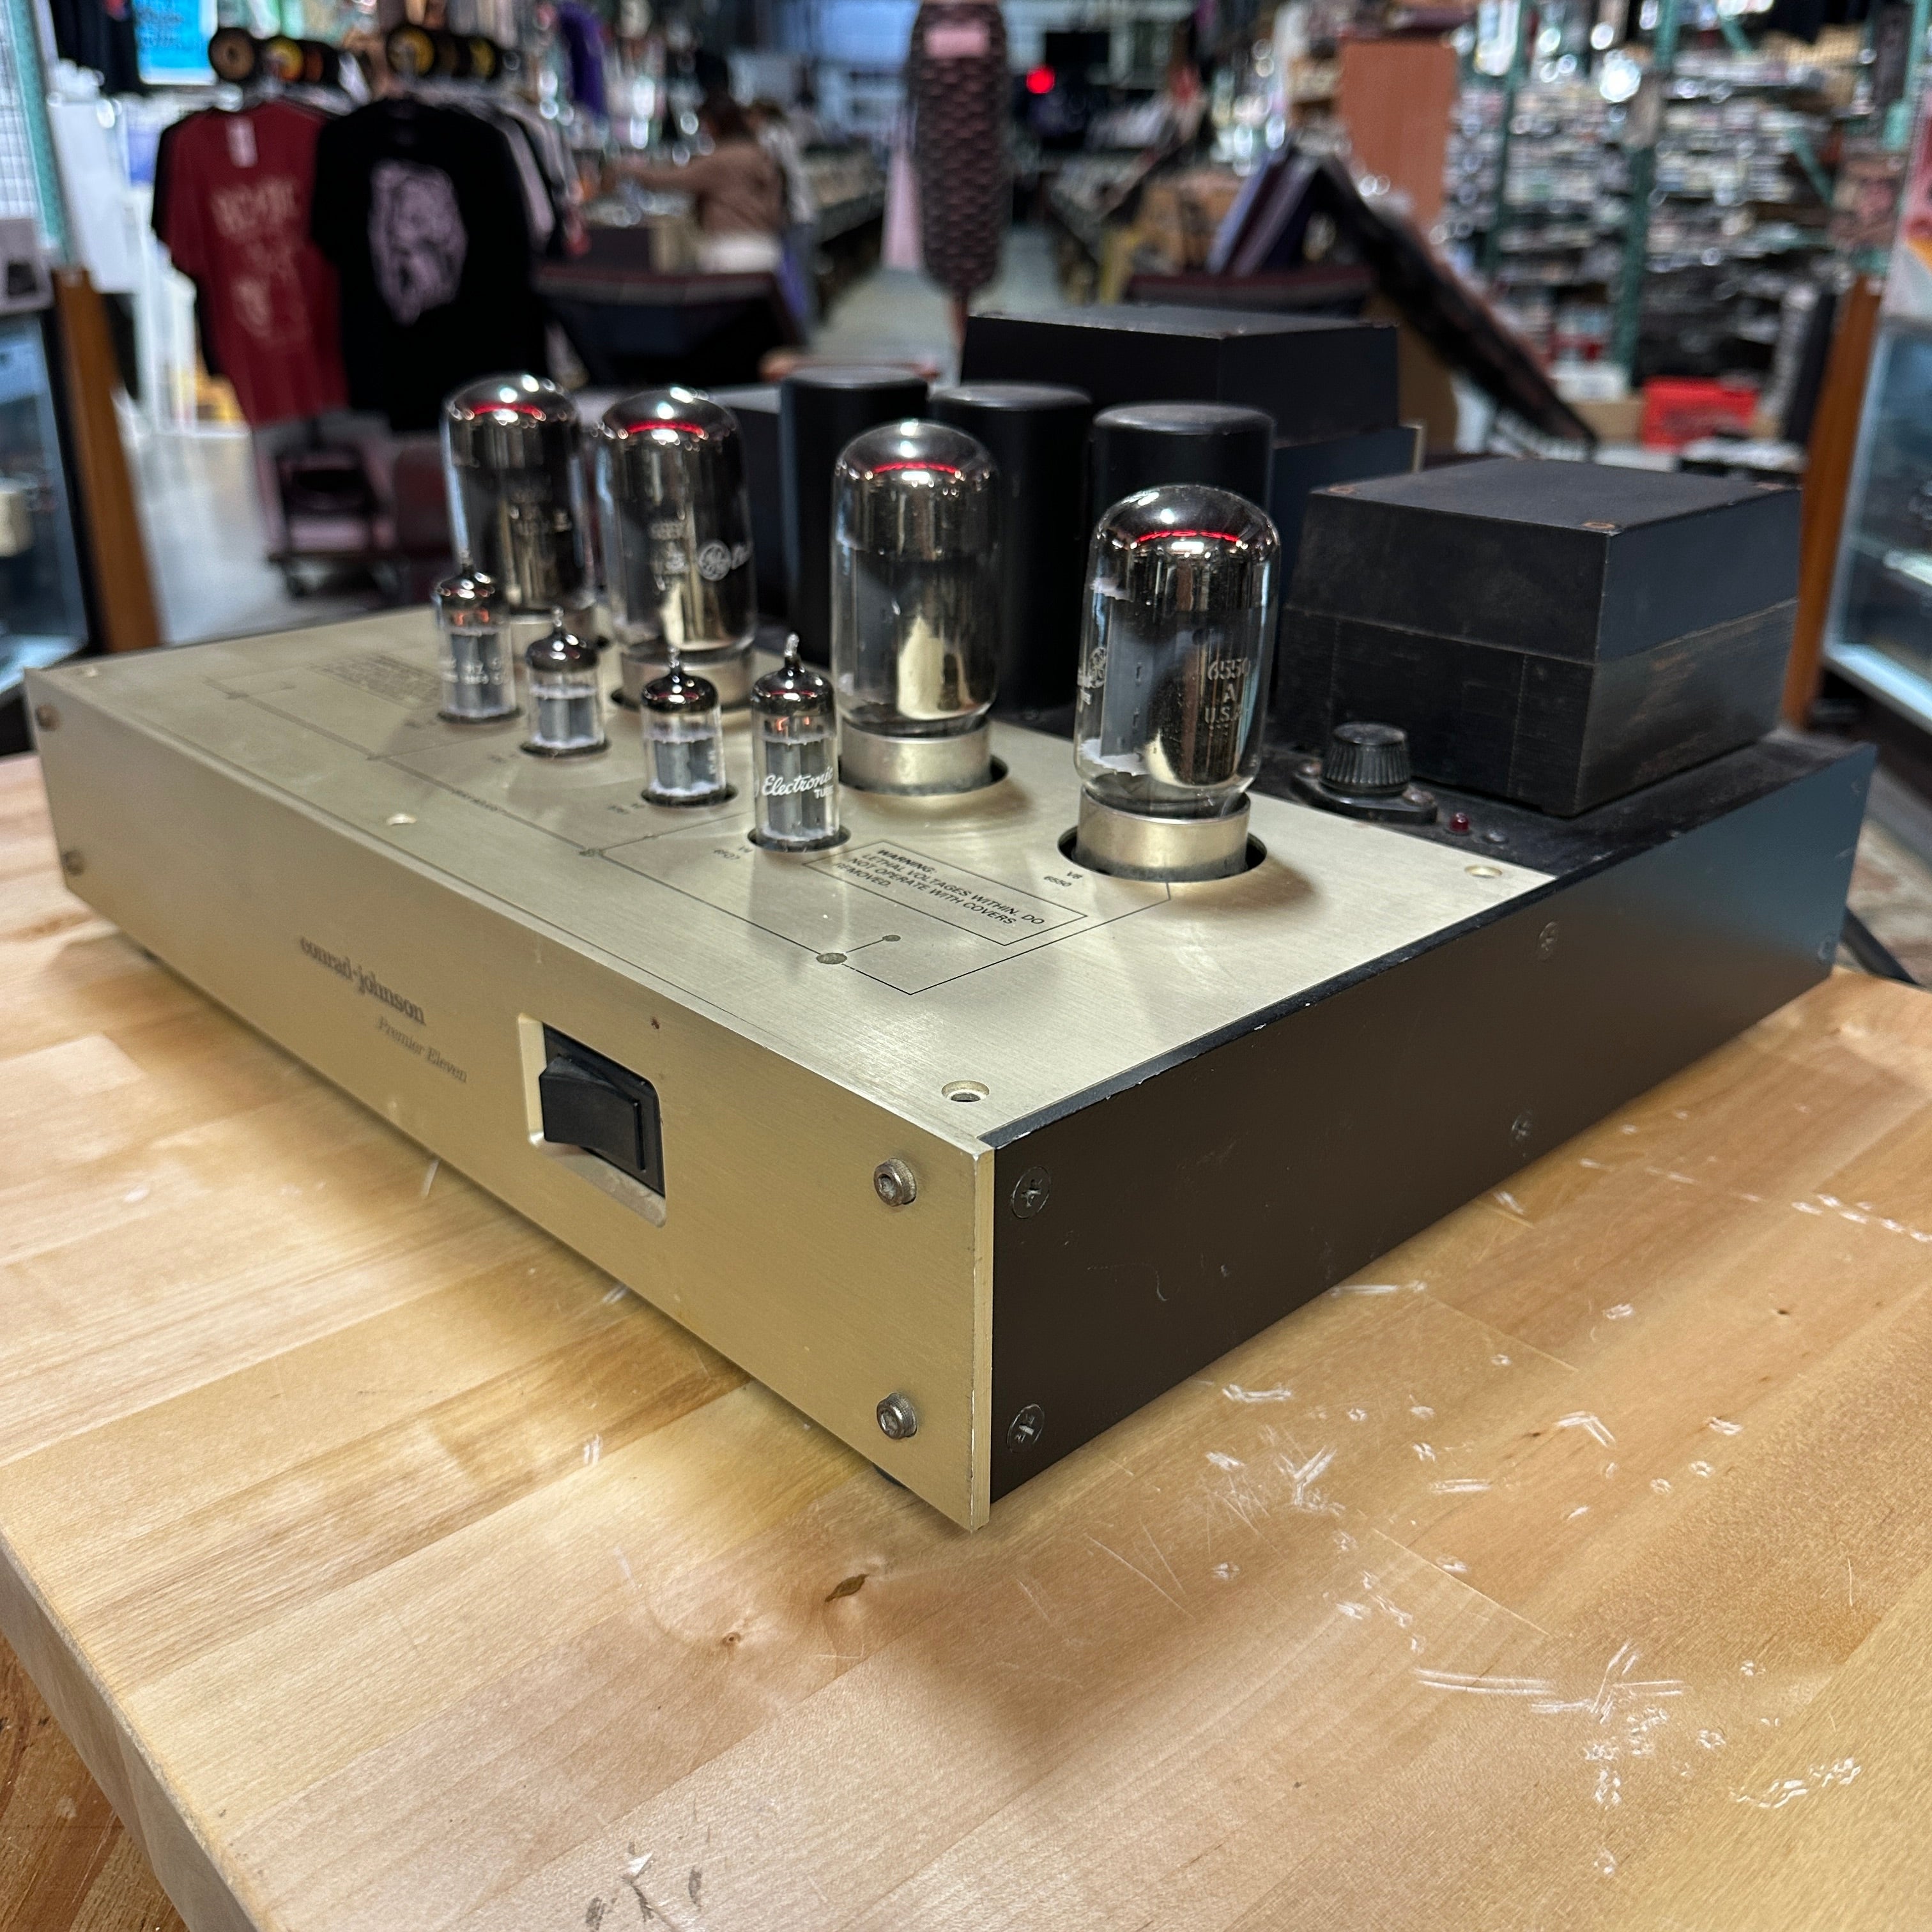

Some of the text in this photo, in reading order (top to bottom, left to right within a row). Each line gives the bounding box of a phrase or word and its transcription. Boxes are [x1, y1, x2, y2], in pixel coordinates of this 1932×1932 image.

[1208, 657, 1251, 680] 6550
[1222, 683, 1236, 703] A
[761, 766, 834, 796] Electronic
[833, 862, 892, 888] REMOVED.
[877, 849, 937, 874] WARNING:
[847, 857, 1017, 924] NOT OPERATE WITH COVERS
[861, 854, 1045, 924] LETHAL VOLTAGES WITHIN. DO
[1043, 876, 1073, 887] 6550
[299, 935, 427, 1027] conrad-johnson
[377, 1015, 468, 1084] Premier Eleven
